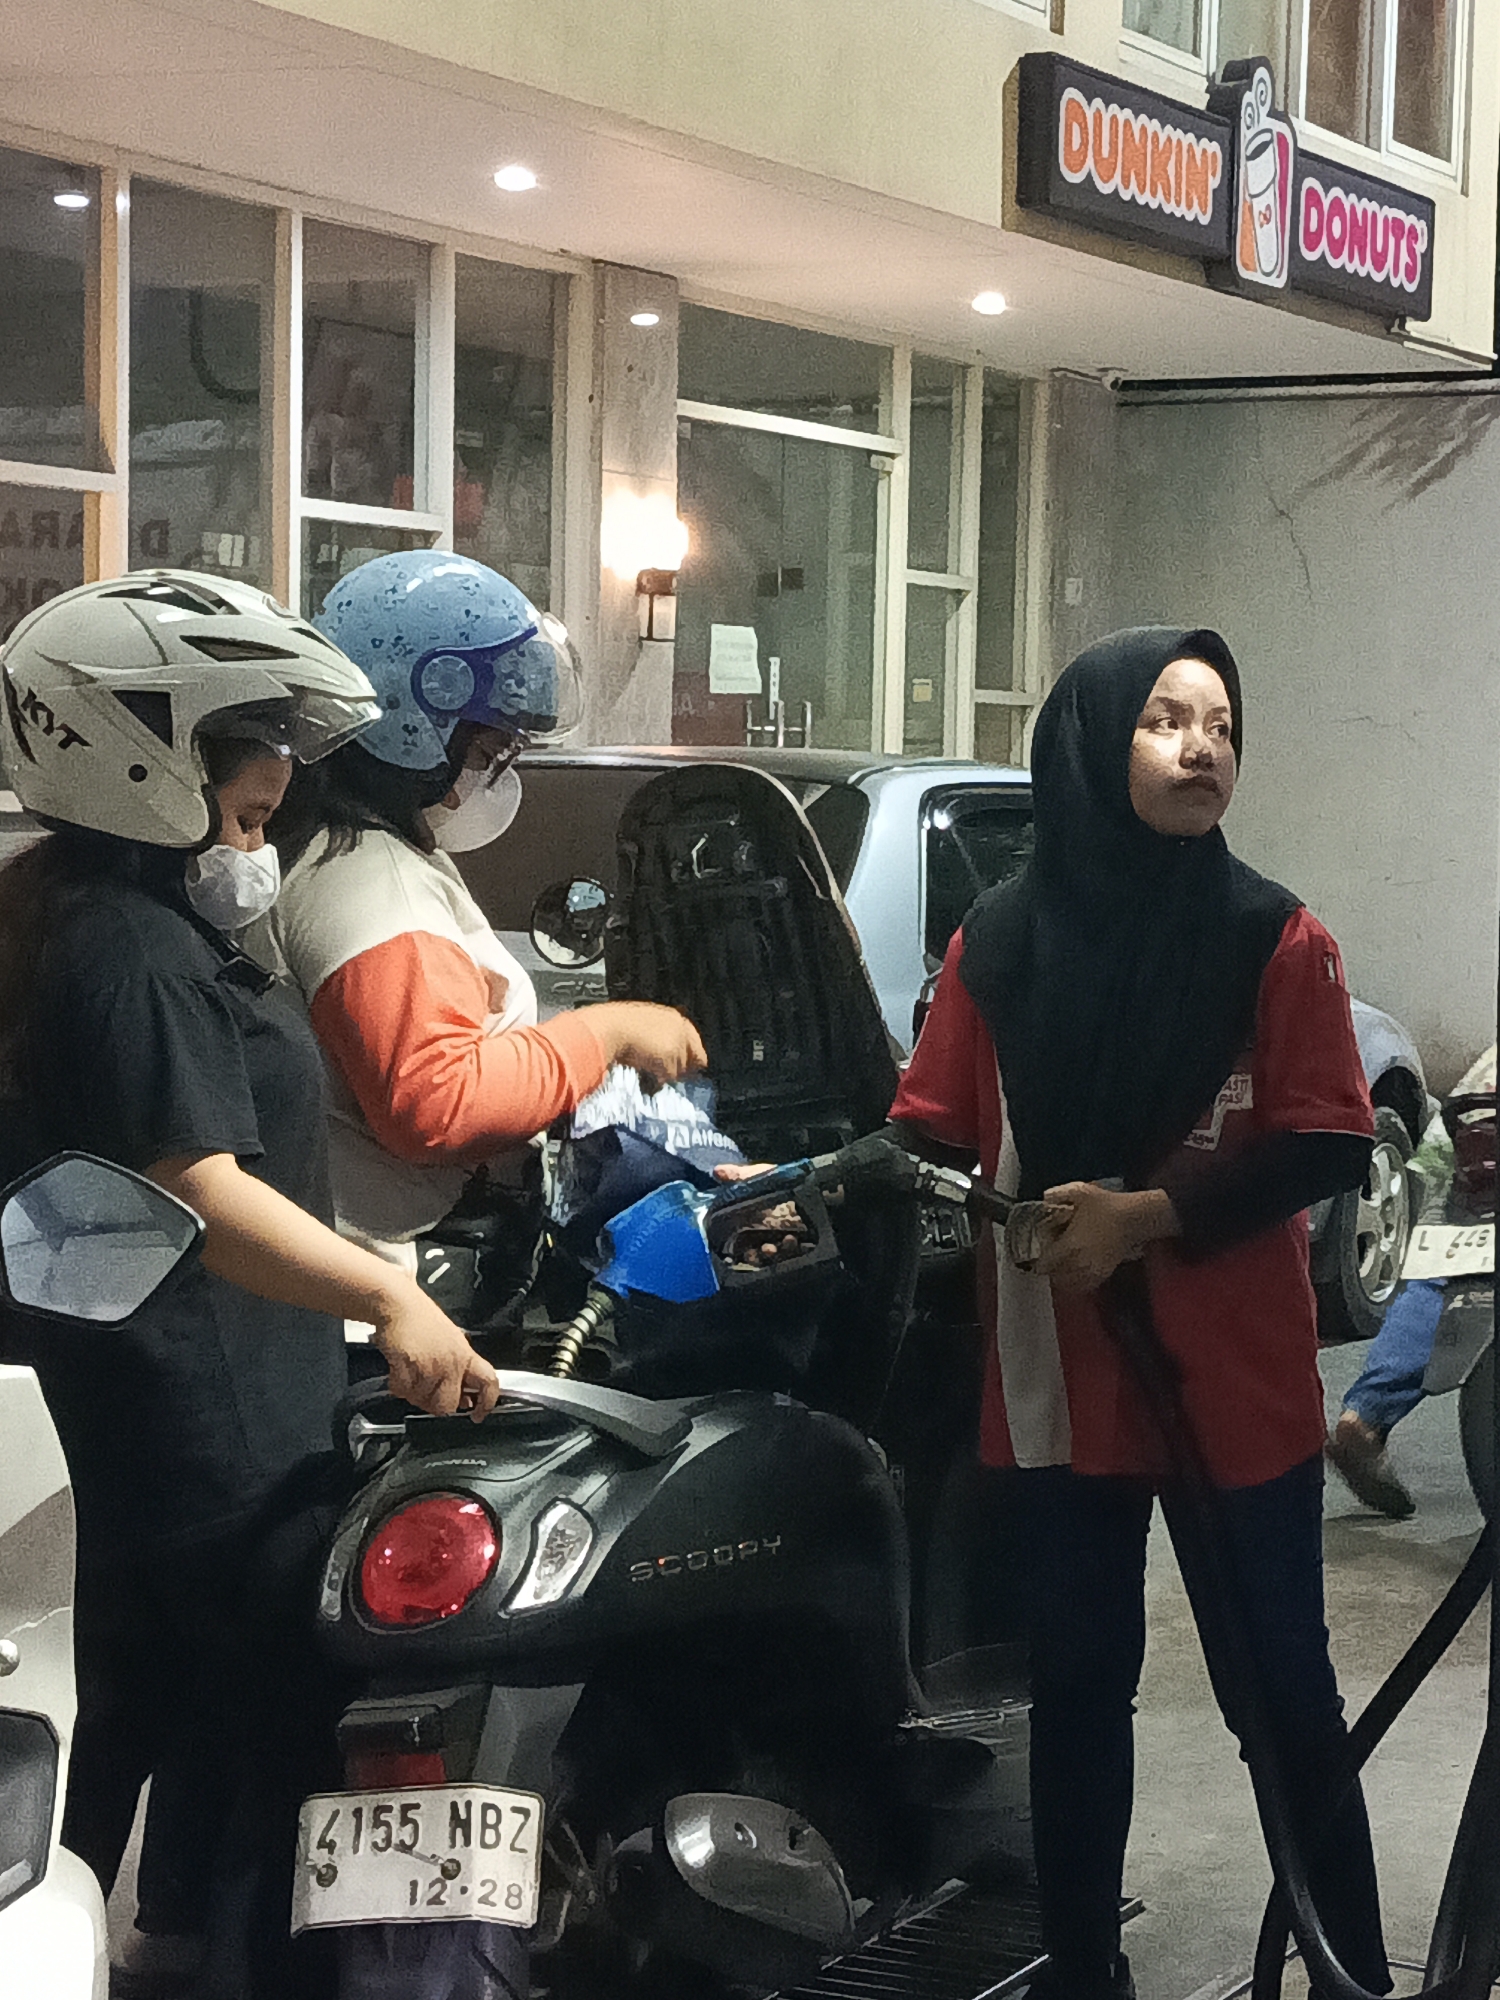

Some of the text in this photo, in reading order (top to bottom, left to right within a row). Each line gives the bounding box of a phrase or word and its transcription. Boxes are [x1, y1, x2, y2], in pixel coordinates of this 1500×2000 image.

[1061, 89, 1221, 223] DUNKIN'
[20, 686, 93, 750] KYT
[1418, 1230, 1430, 1251] L
[629, 1534, 782, 1583] SCOOPY
[316, 1799, 531, 1855] 4155 NBZ
